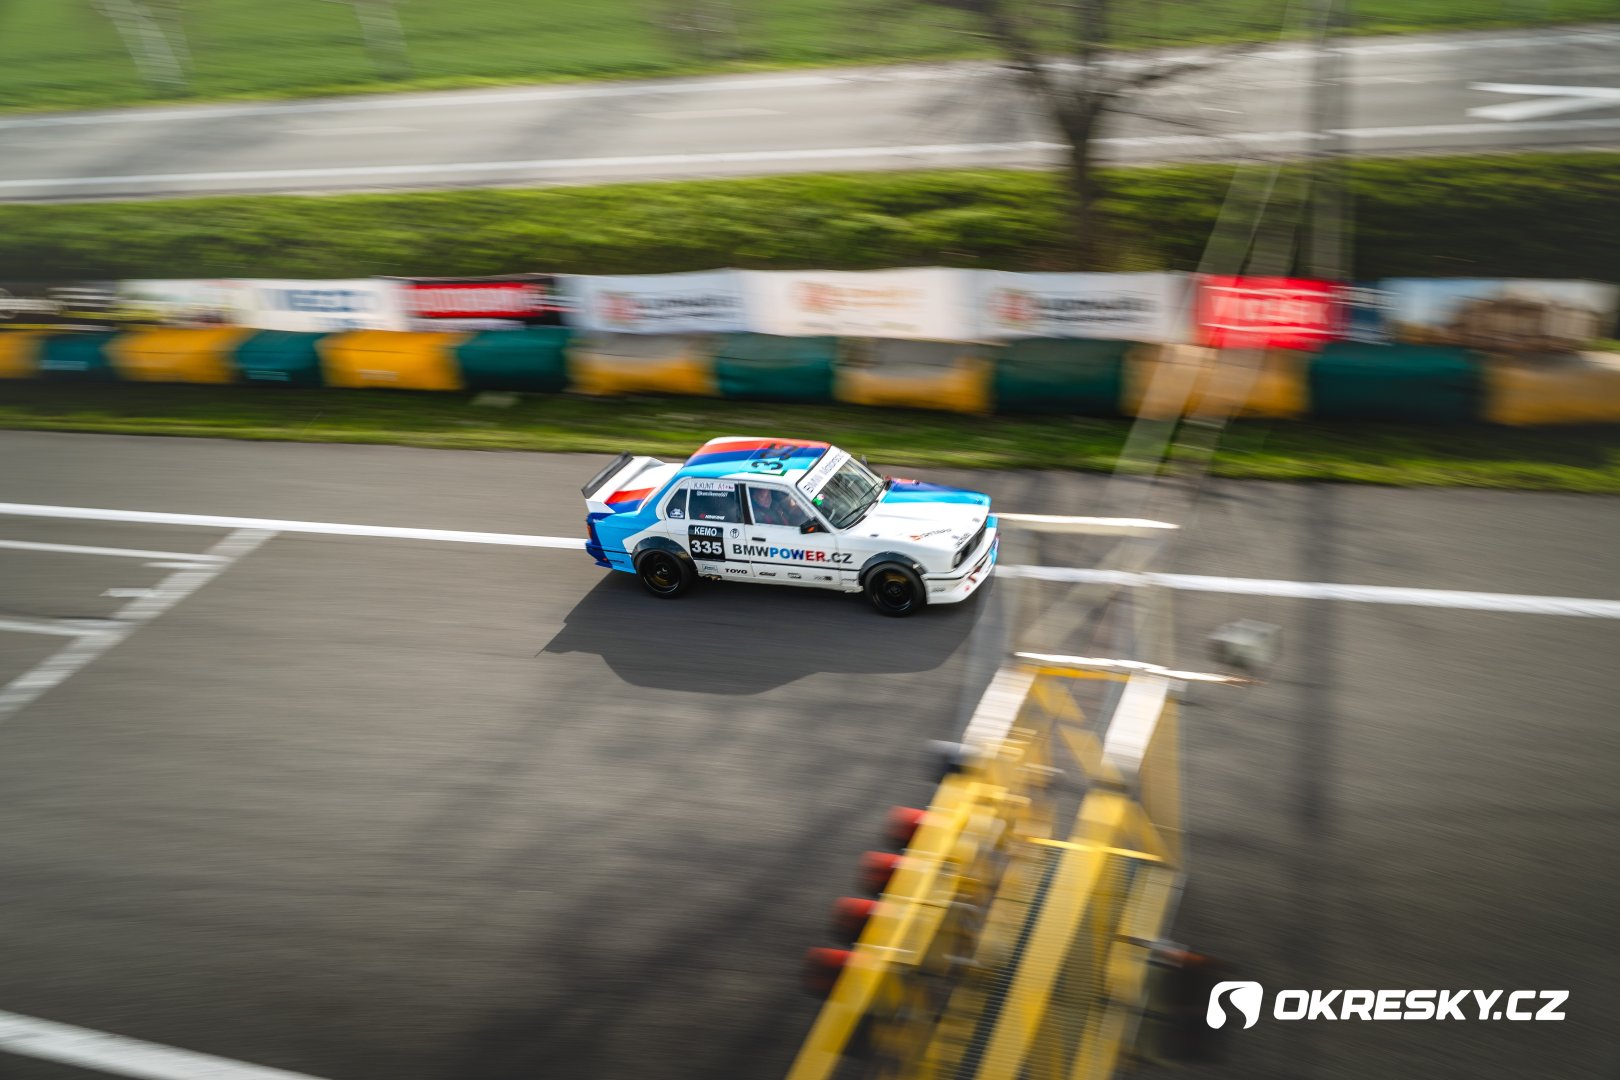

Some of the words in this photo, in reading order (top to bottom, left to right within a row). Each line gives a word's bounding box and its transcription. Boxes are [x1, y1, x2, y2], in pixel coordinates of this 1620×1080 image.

[694, 526, 717, 537] KEMO
[691, 540, 722, 555] 335
[733, 543, 853, 564] BMWPOWER.CZ
